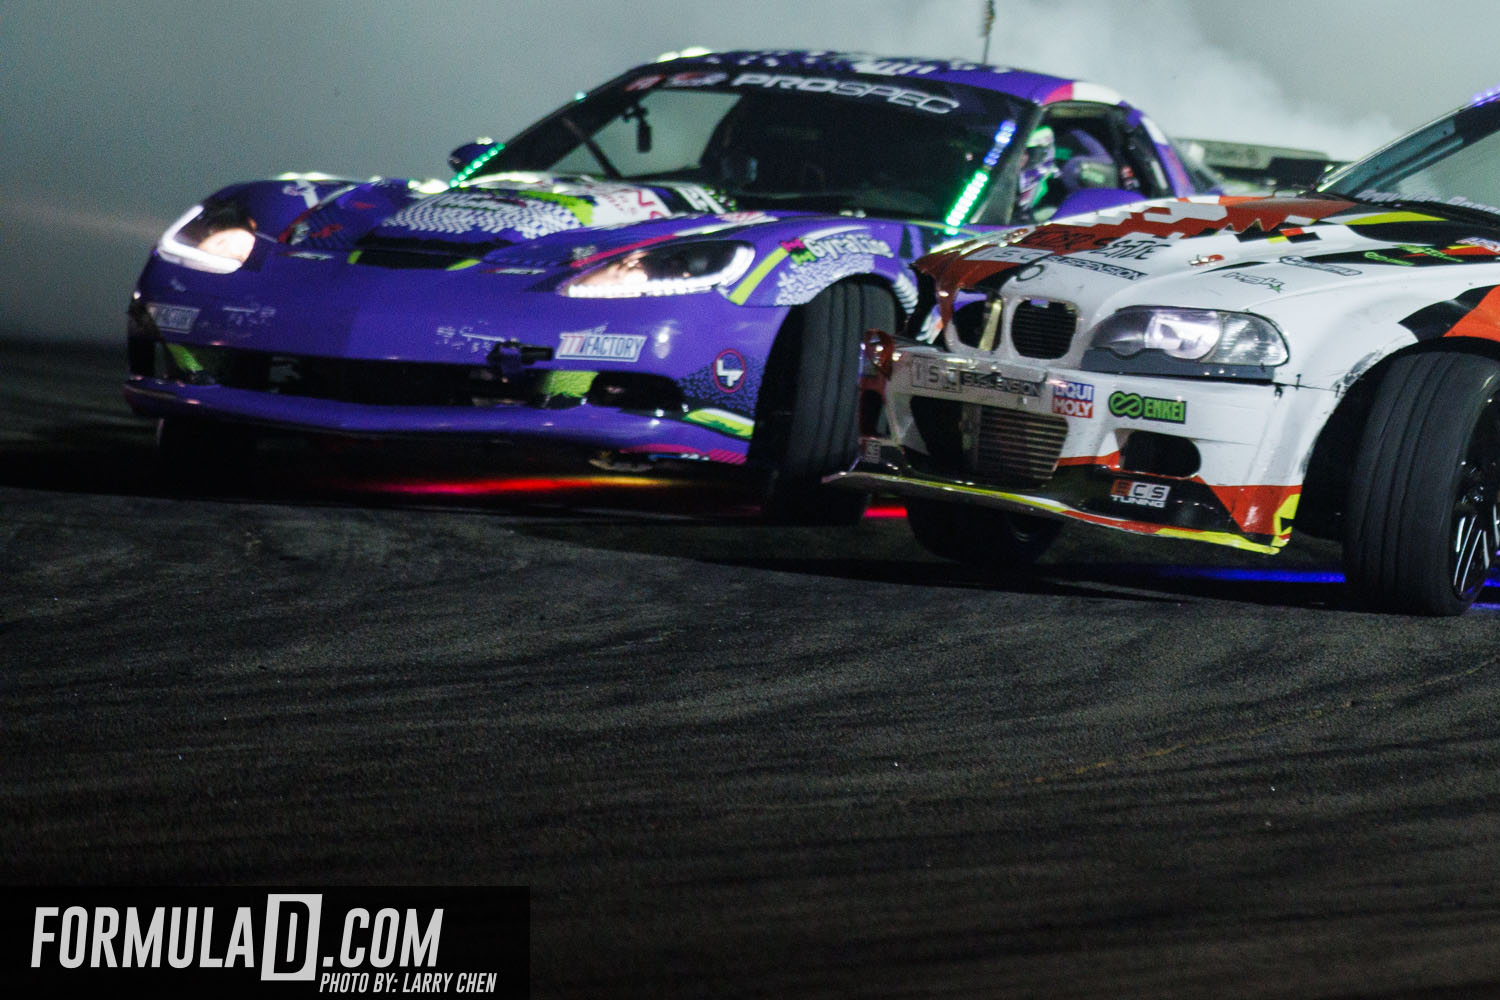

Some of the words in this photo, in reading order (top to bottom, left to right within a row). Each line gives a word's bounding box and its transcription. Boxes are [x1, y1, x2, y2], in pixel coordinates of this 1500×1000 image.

[732, 72, 960, 114] PROSPEC
[1053, 398, 1093, 417] MOLY
[1144, 398, 1186, 422] ENKEI
[1116, 480, 1168, 500] ECS
[1110, 494, 1166, 508] TUNING
